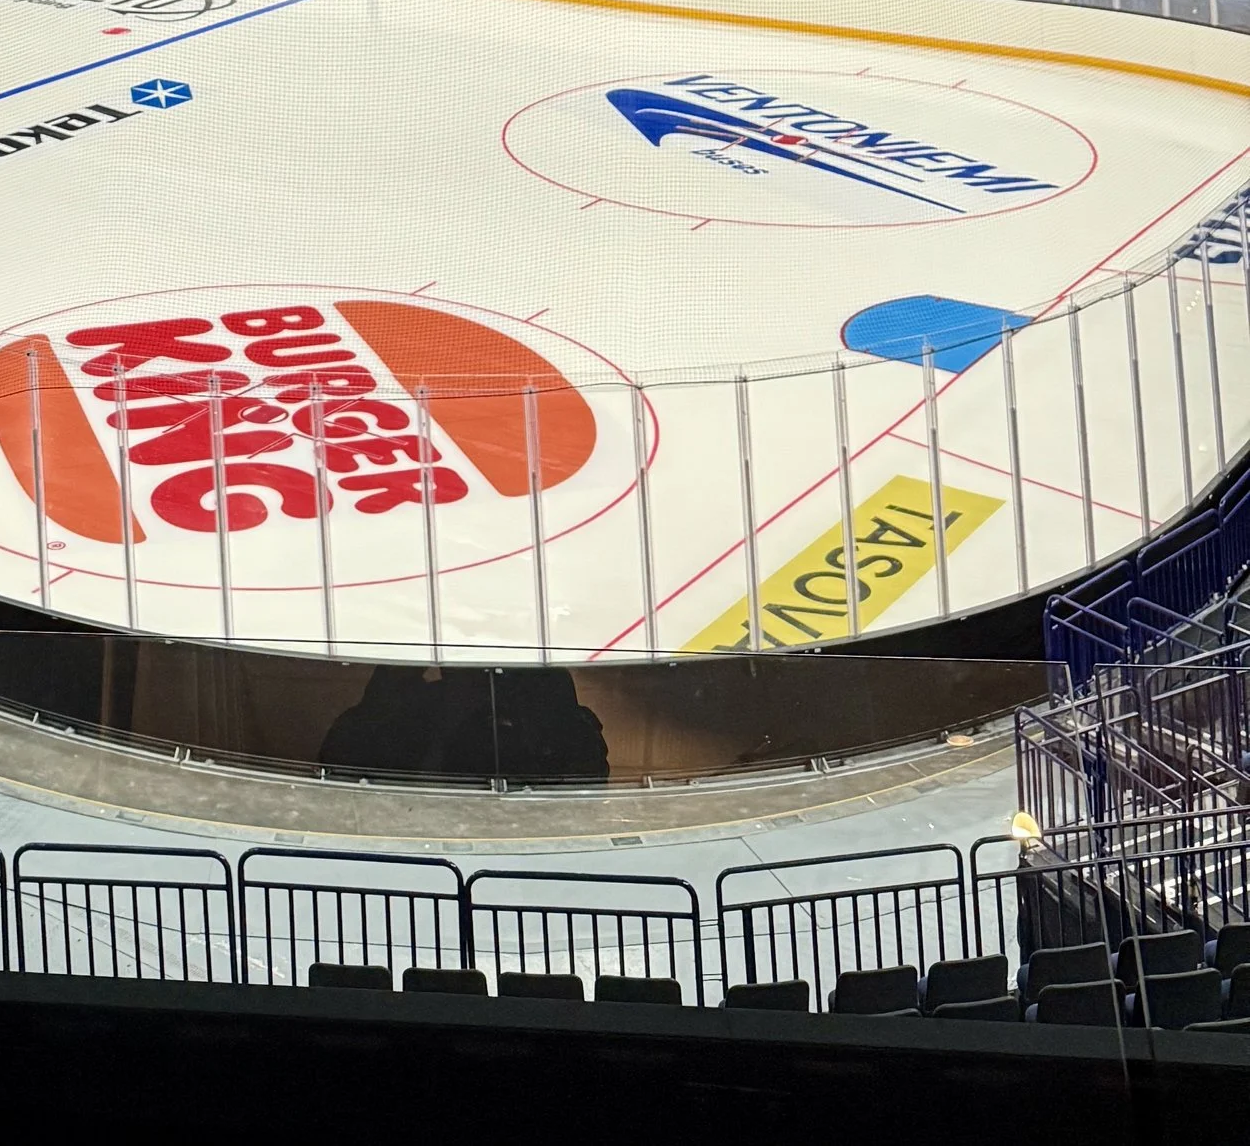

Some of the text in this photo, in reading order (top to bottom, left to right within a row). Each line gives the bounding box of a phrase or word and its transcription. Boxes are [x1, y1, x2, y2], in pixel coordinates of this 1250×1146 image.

[663, 74, 1061, 194] VENTONIEMI
[691, 148, 770, 175] buses
[65, 317, 336, 533] KING
[220, 305, 469, 515] BURGER
